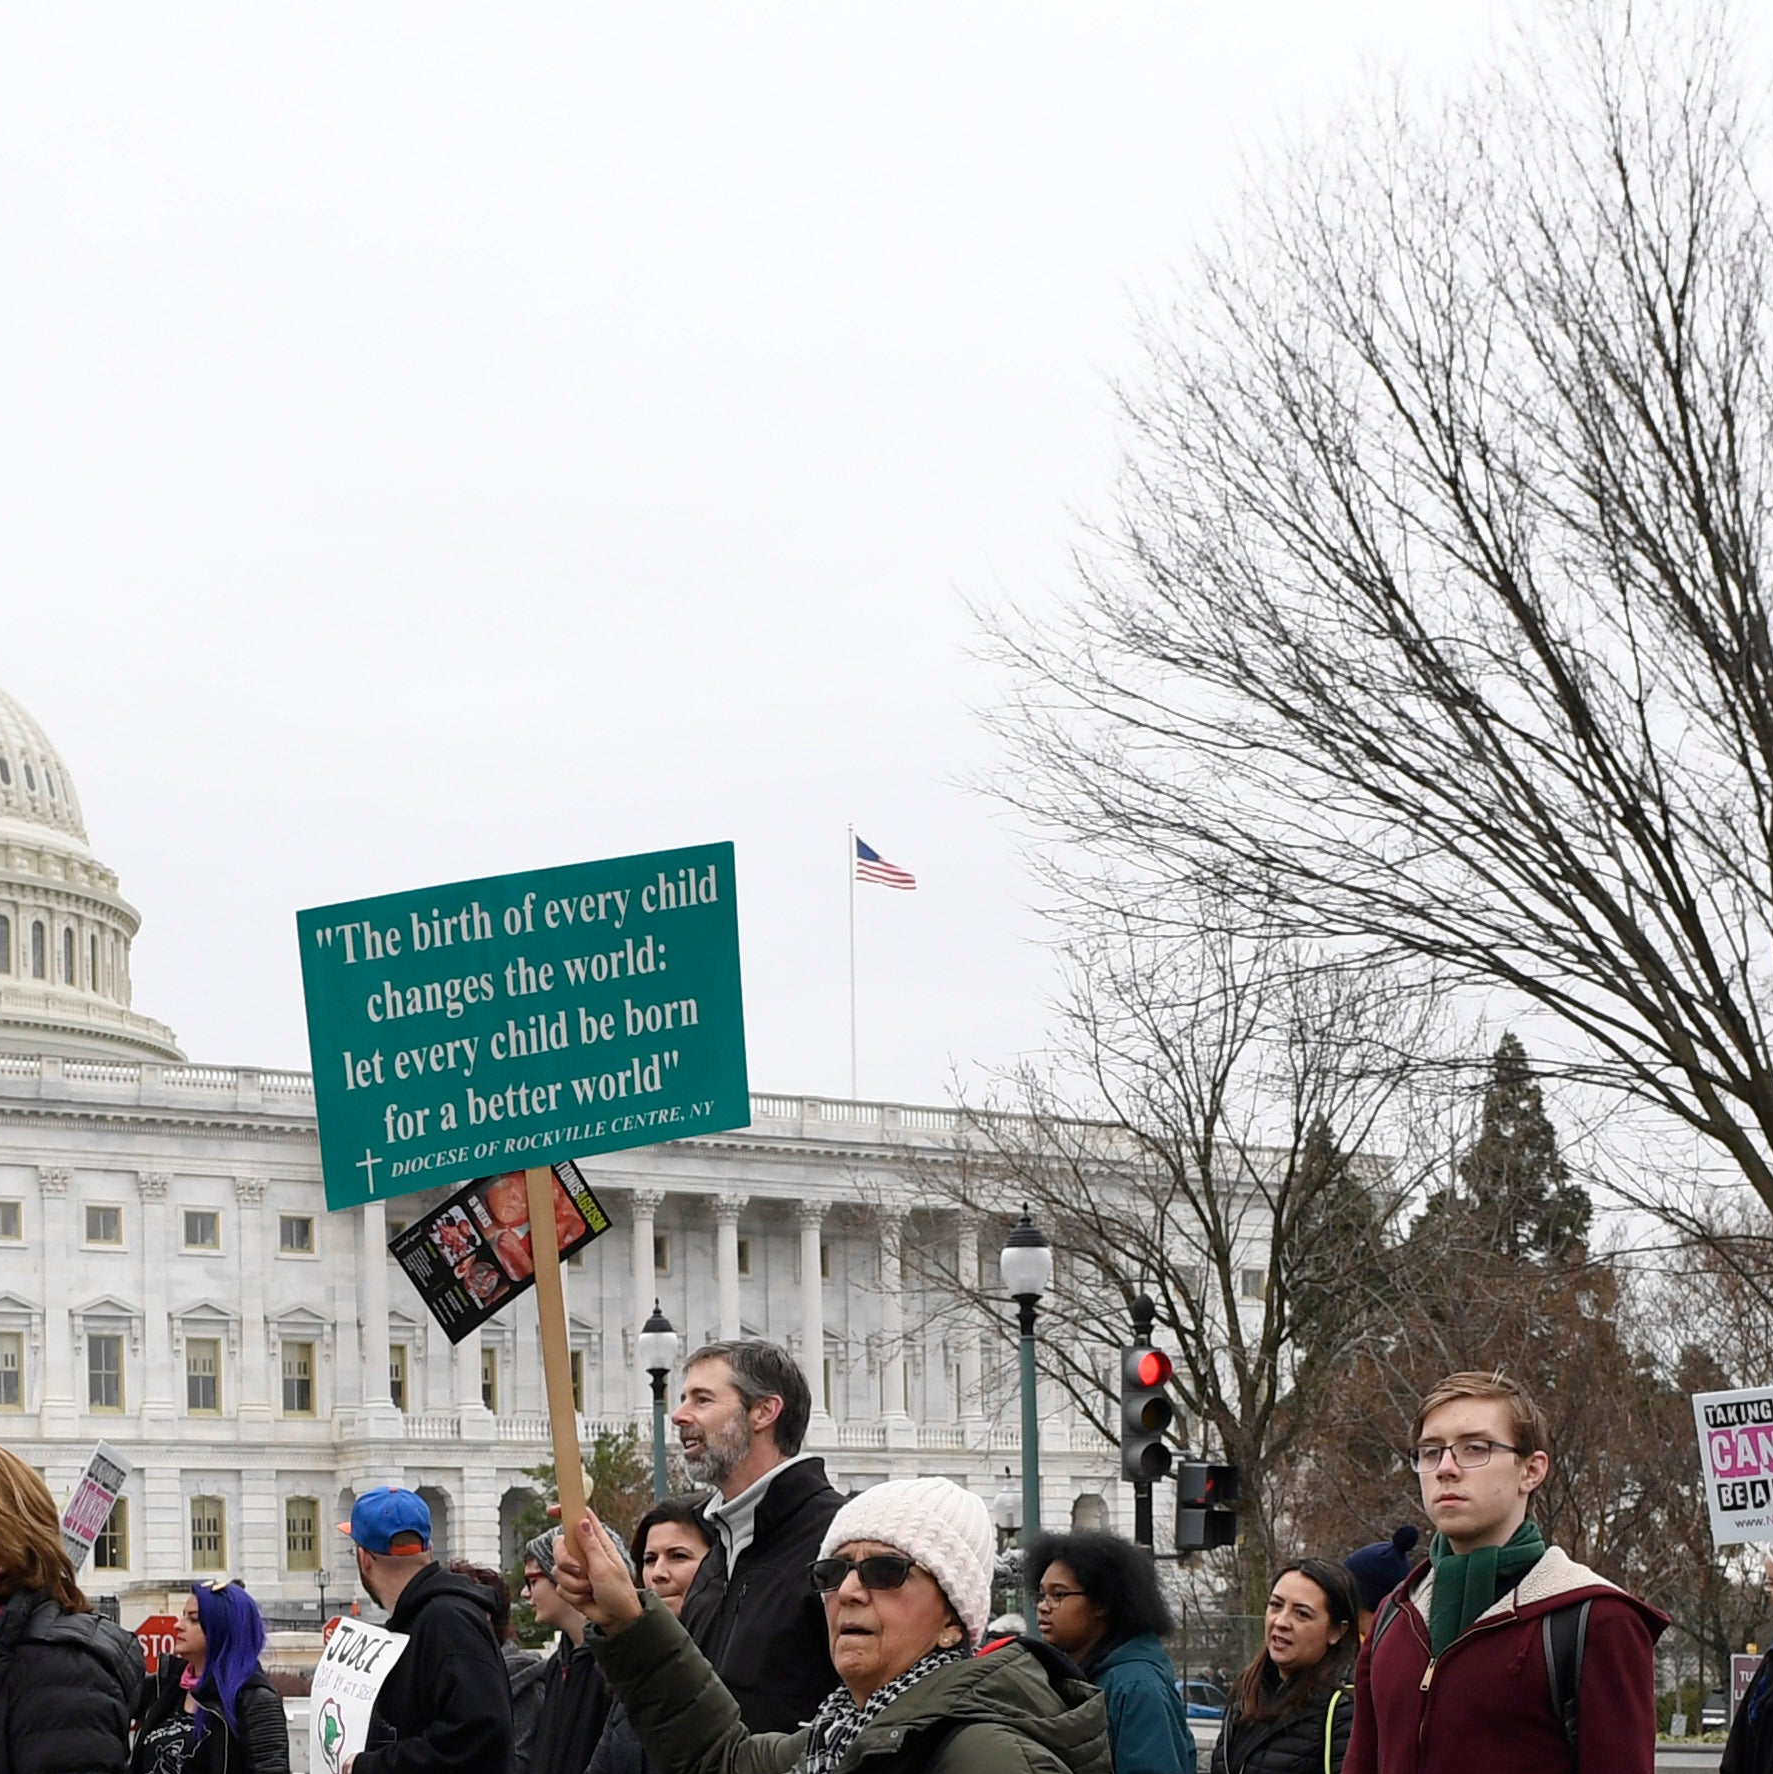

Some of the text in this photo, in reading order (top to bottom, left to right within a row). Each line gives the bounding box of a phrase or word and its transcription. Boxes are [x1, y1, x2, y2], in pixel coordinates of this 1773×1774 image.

[316, 864, 718, 964] "The birth of every child
[367, 936, 667, 1022] changes the world:
[342, 997, 699, 1090] let every child be born
[383, 1050, 680, 1144] for a better world"
[391, 1100, 714, 1178] DIOCESE OF ROCKVILLE CENTRE, NY
[1705, 1403, 1772, 1426] TAKING
[1722, 1486, 1747, 1507] BE
[1755, 1483, 1768, 1504] A
[138, 1634, 176, 1658] STO
[327, 1625, 393, 1674] JUDGE
